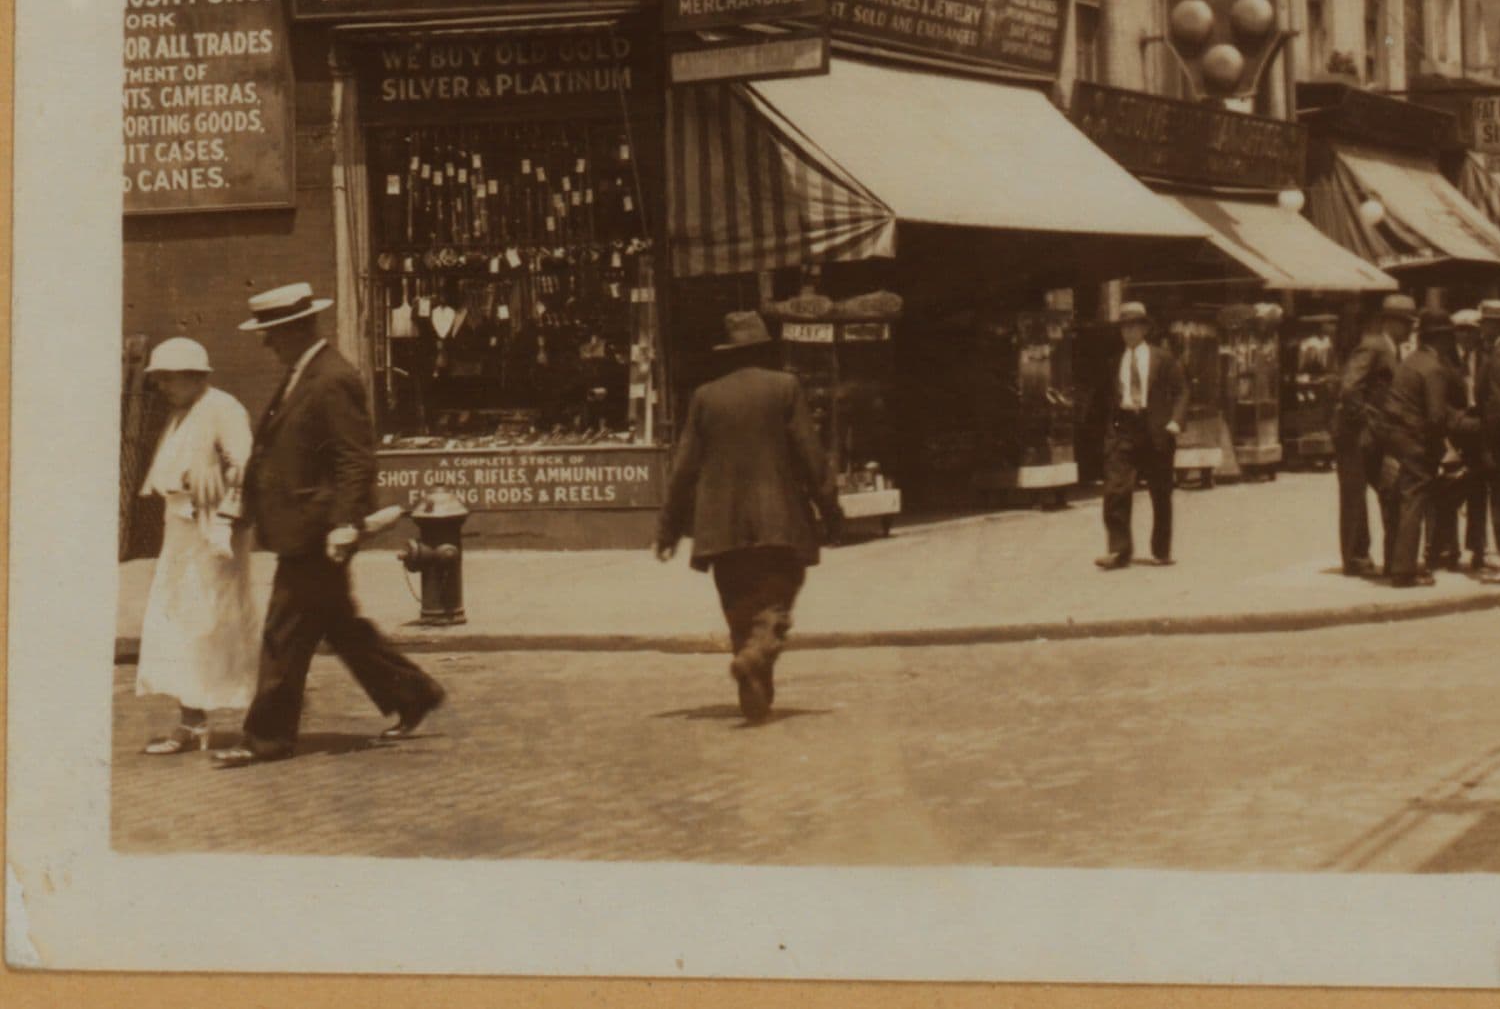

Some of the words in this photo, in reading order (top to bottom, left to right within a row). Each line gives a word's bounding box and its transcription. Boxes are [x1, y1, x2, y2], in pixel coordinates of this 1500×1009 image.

[154, 33, 190, 59] ALL
[193, 29, 273, 57] TRADES
[382, 47, 422, 70] WE
[430, 46, 482, 69] BUY
[495, 41, 547, 66] OLD
[183, 63, 209, 82] OF
[381, 74, 469, 102] SILVER
[475, 77, 491, 98] &
[495, 66, 632, 97] PLATINUM
[439, 458, 449, 468] A
[453, 456, 513, 468] COMPLETE
[519, 455, 563, 466] STOCK
[569, 455, 586, 465] OF
[377, 469, 419, 488] SHOT
[534, 465, 649, 483] AMMUNITION
[485, 486, 533, 504] RODS
[537, 489, 550, 503] &
[554, 484, 616, 502] REELS
